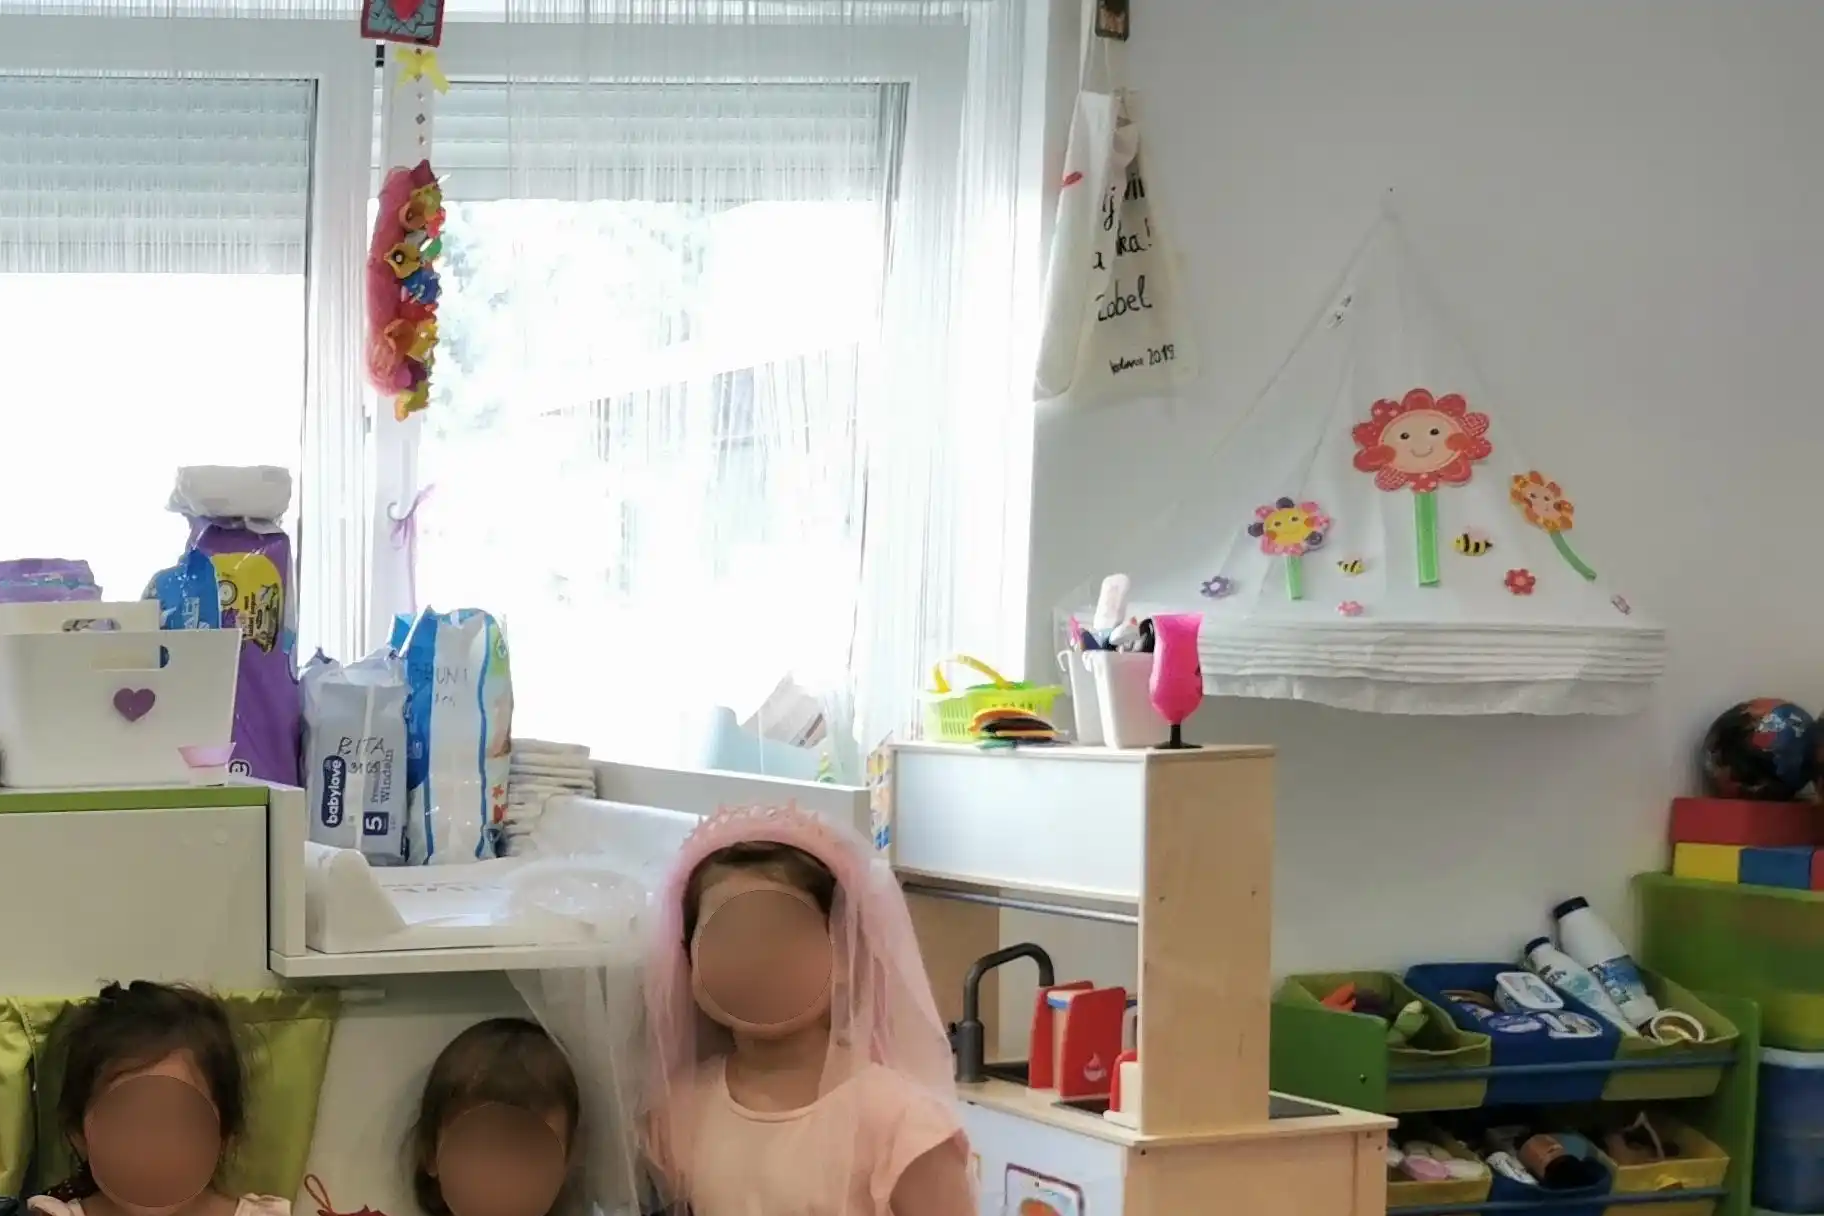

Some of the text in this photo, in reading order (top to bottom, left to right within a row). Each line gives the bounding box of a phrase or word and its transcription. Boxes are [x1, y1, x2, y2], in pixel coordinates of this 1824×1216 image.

[336, 736, 386, 756] RITA
[327, 759, 342, 824] babylove
[366, 816, 382, 831] 5
